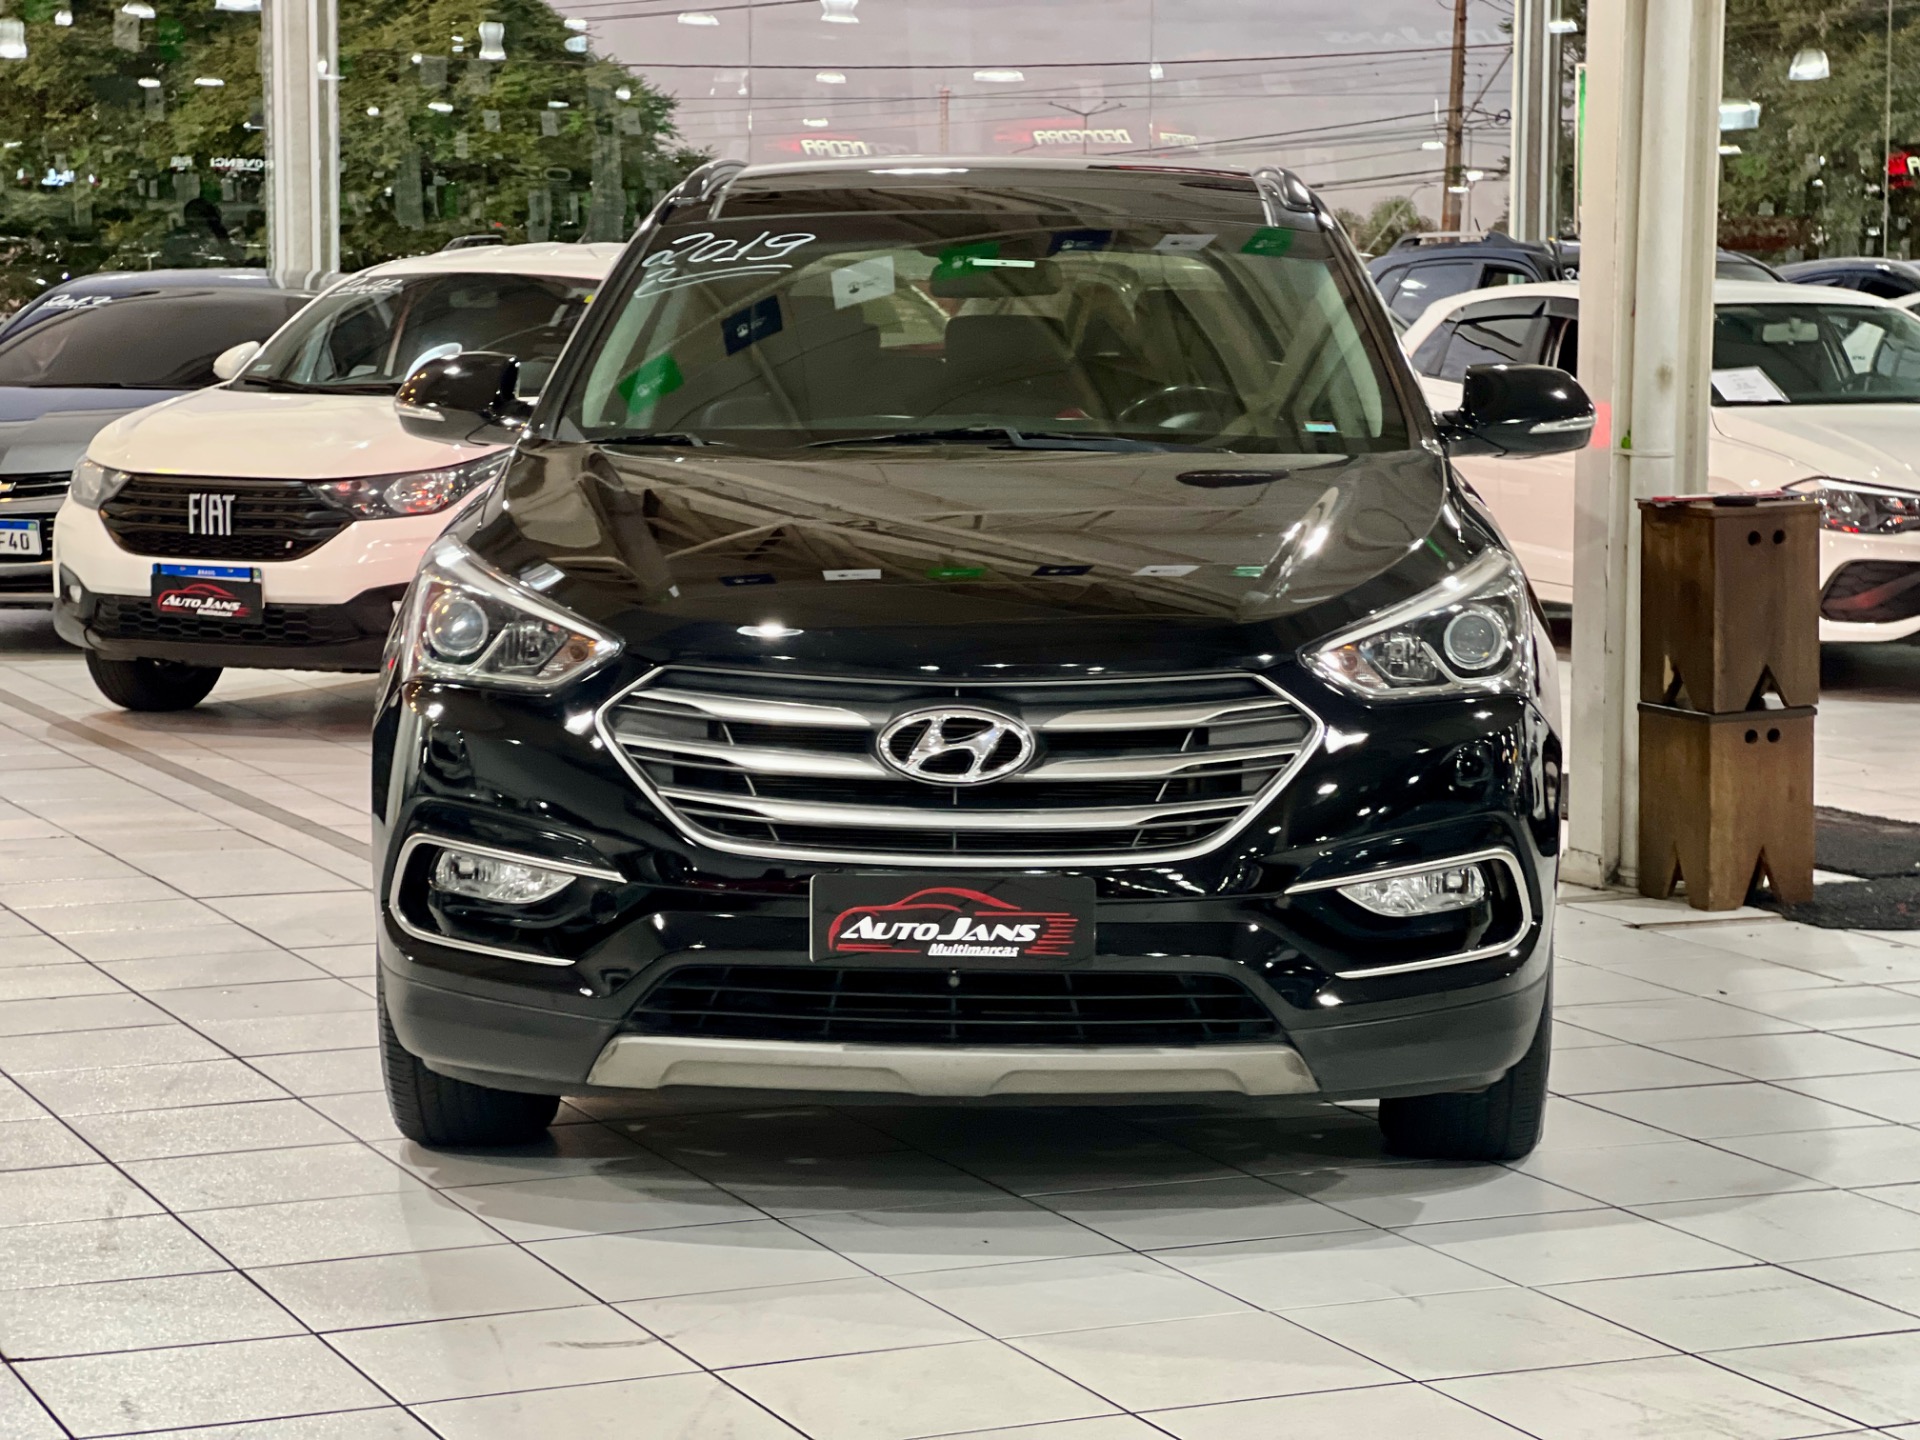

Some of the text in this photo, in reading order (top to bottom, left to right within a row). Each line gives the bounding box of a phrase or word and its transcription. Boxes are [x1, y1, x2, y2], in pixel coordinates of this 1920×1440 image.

[642, 231, 816, 267] 2019
[189, 493, 235, 535] FIAT
[840, 916, 1040, 942] AUTO JANS
[928, 943, 1019, 957] Multimarcas
